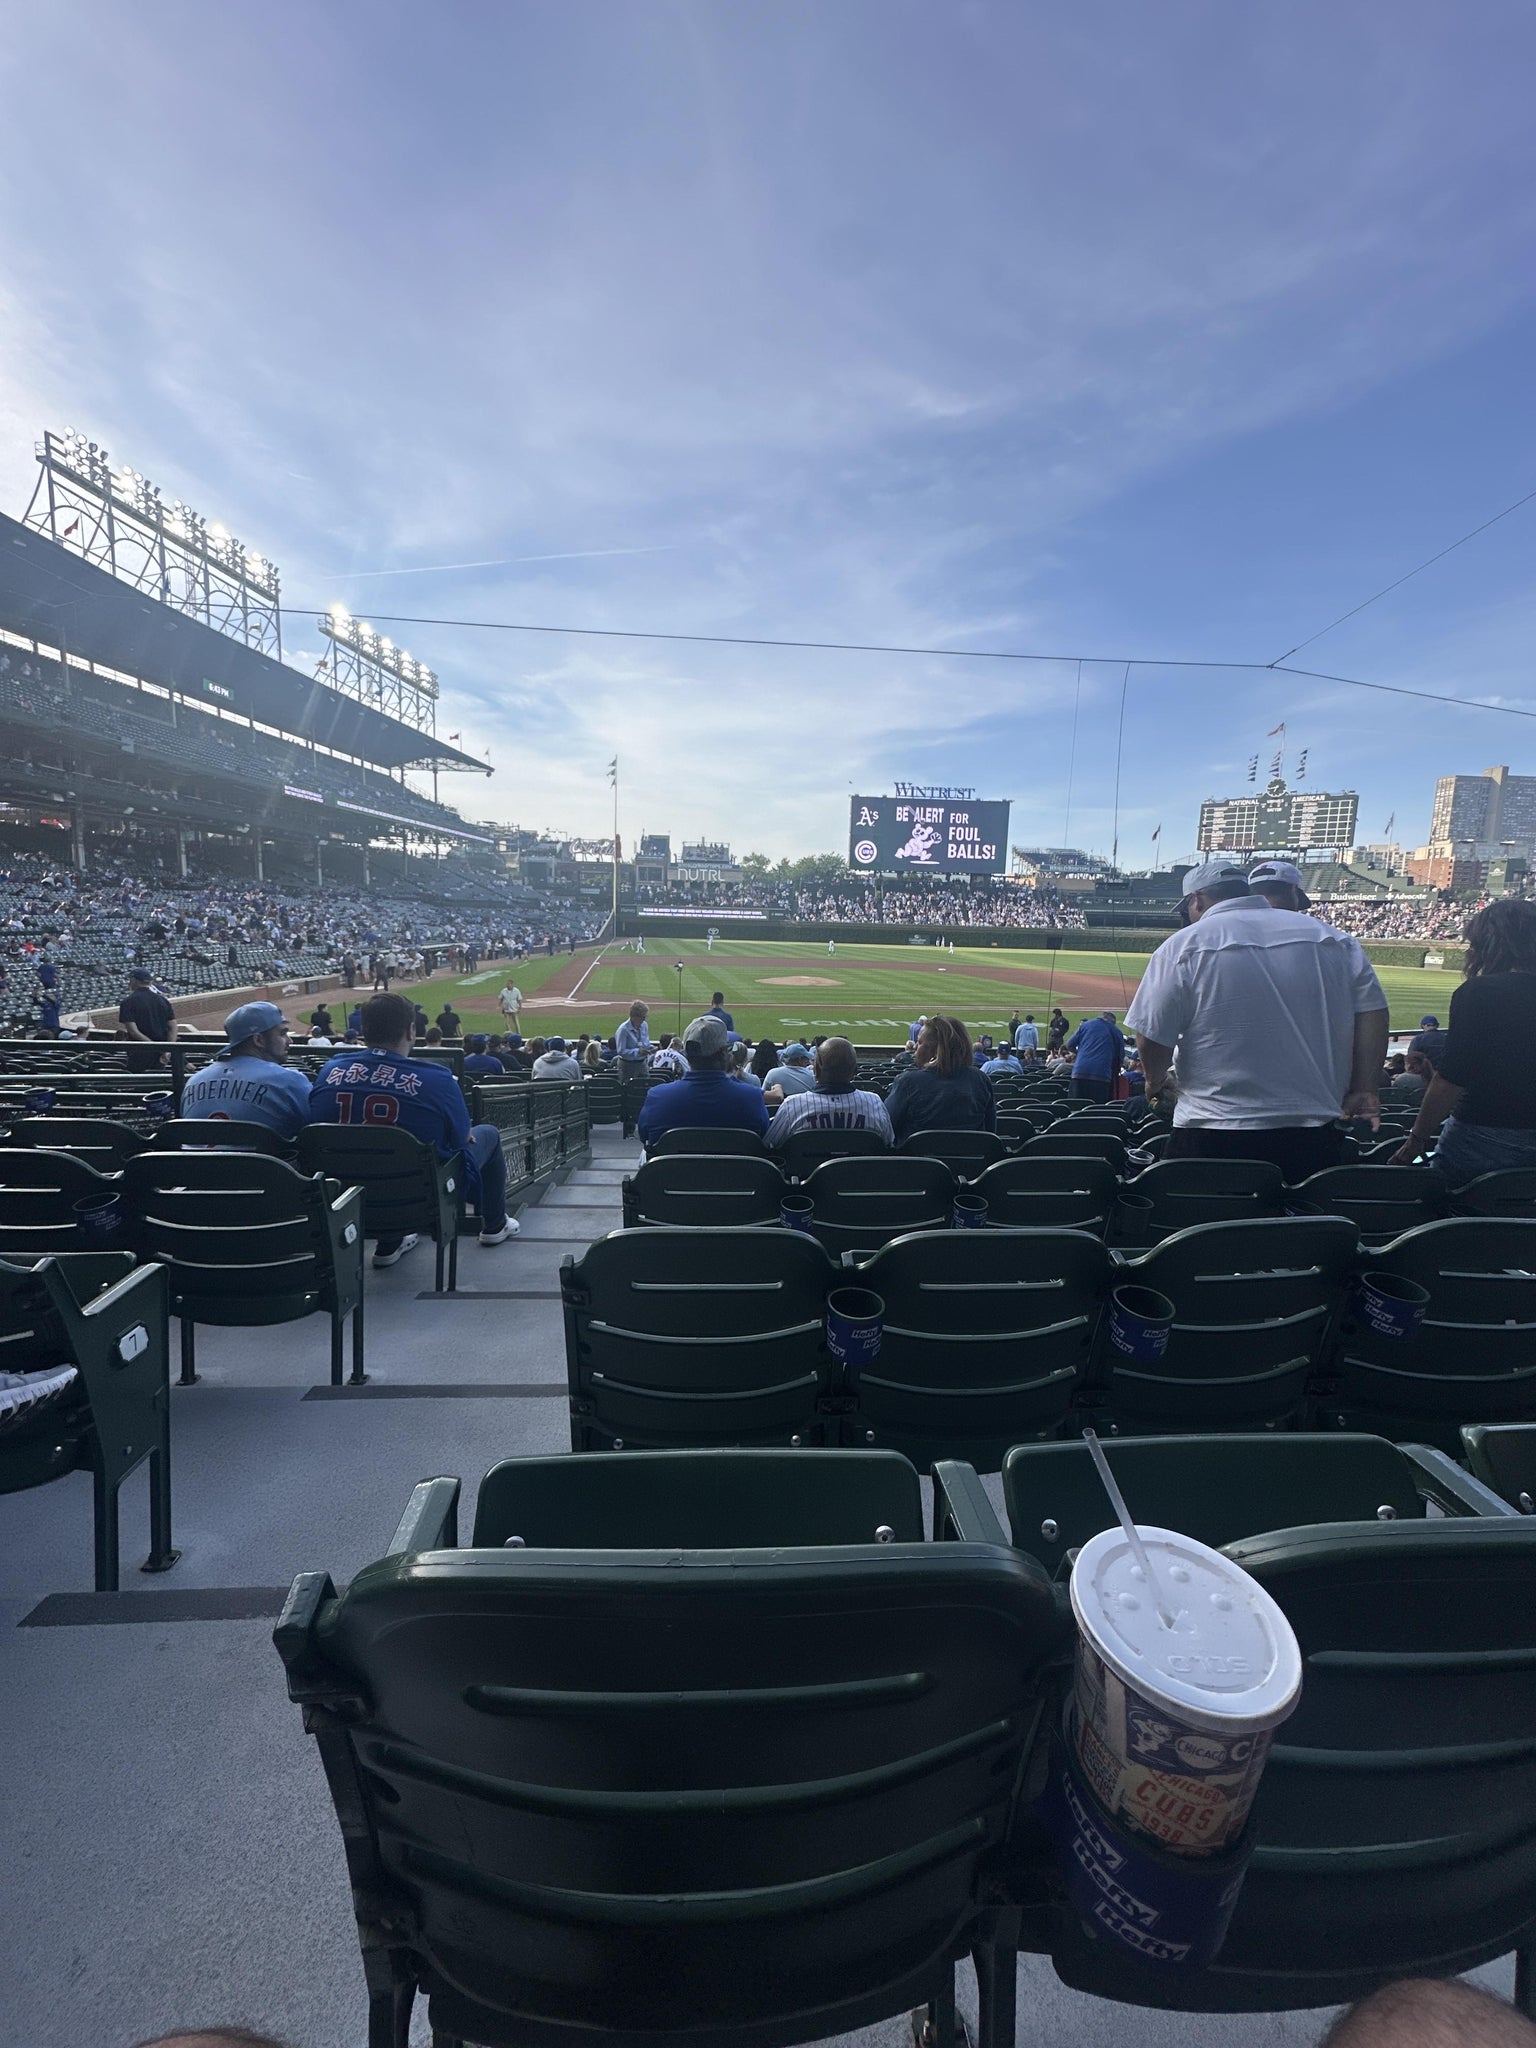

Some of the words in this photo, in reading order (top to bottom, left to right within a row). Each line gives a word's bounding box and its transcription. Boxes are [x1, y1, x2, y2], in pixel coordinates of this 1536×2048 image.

[894, 782, 976, 799] WINTRUST
[896, 806, 909, 822] BE
[913, 807, 945, 823] ALERT
[950, 813, 969, 824] FOR
[948, 827, 981, 841] FOUL
[947, 843, 996, 860] BALLS!
[184, 1078, 268, 1106] HOERNER
[326, 1062, 422, 1097] 今永昇太
[1177, 1739, 1227, 1763] CHICAGO
[1158, 1770, 1221, 1802] CHICAGO
[1135, 1779, 1215, 1831] CUBS
[1141, 1809, 1184, 1843] 1938
[1075, 1841, 1153, 1925] Hefty
[1100, 1905, 1186, 1960] Hefty
